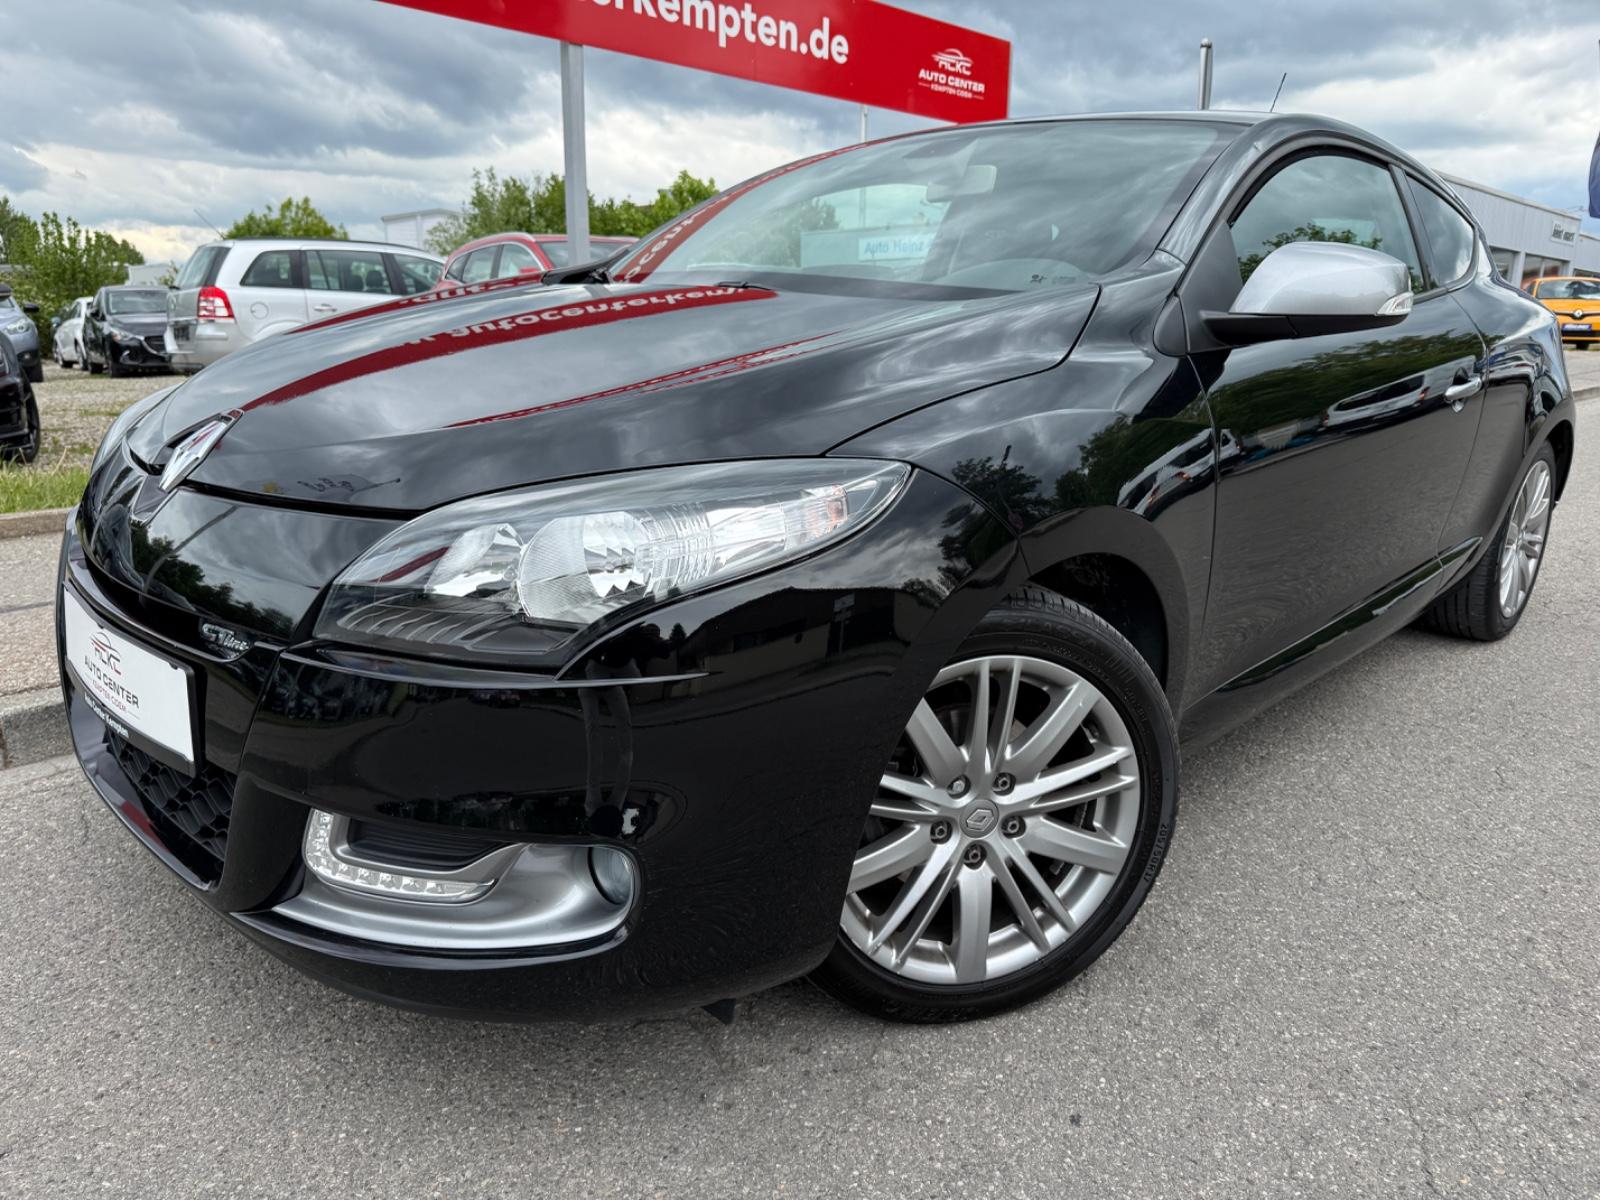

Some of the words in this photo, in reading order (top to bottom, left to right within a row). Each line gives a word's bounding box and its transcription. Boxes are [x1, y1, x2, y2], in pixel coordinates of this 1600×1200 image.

[592, 0, 849, 64] empten.de
[918, 68, 947, 84] AUTO
[948, 75, 986, 94] CENTER
[864, 241, 889, 254] Auto
[84, 655, 102, 681] AUTO
[102, 672, 140, 709] CENTER
